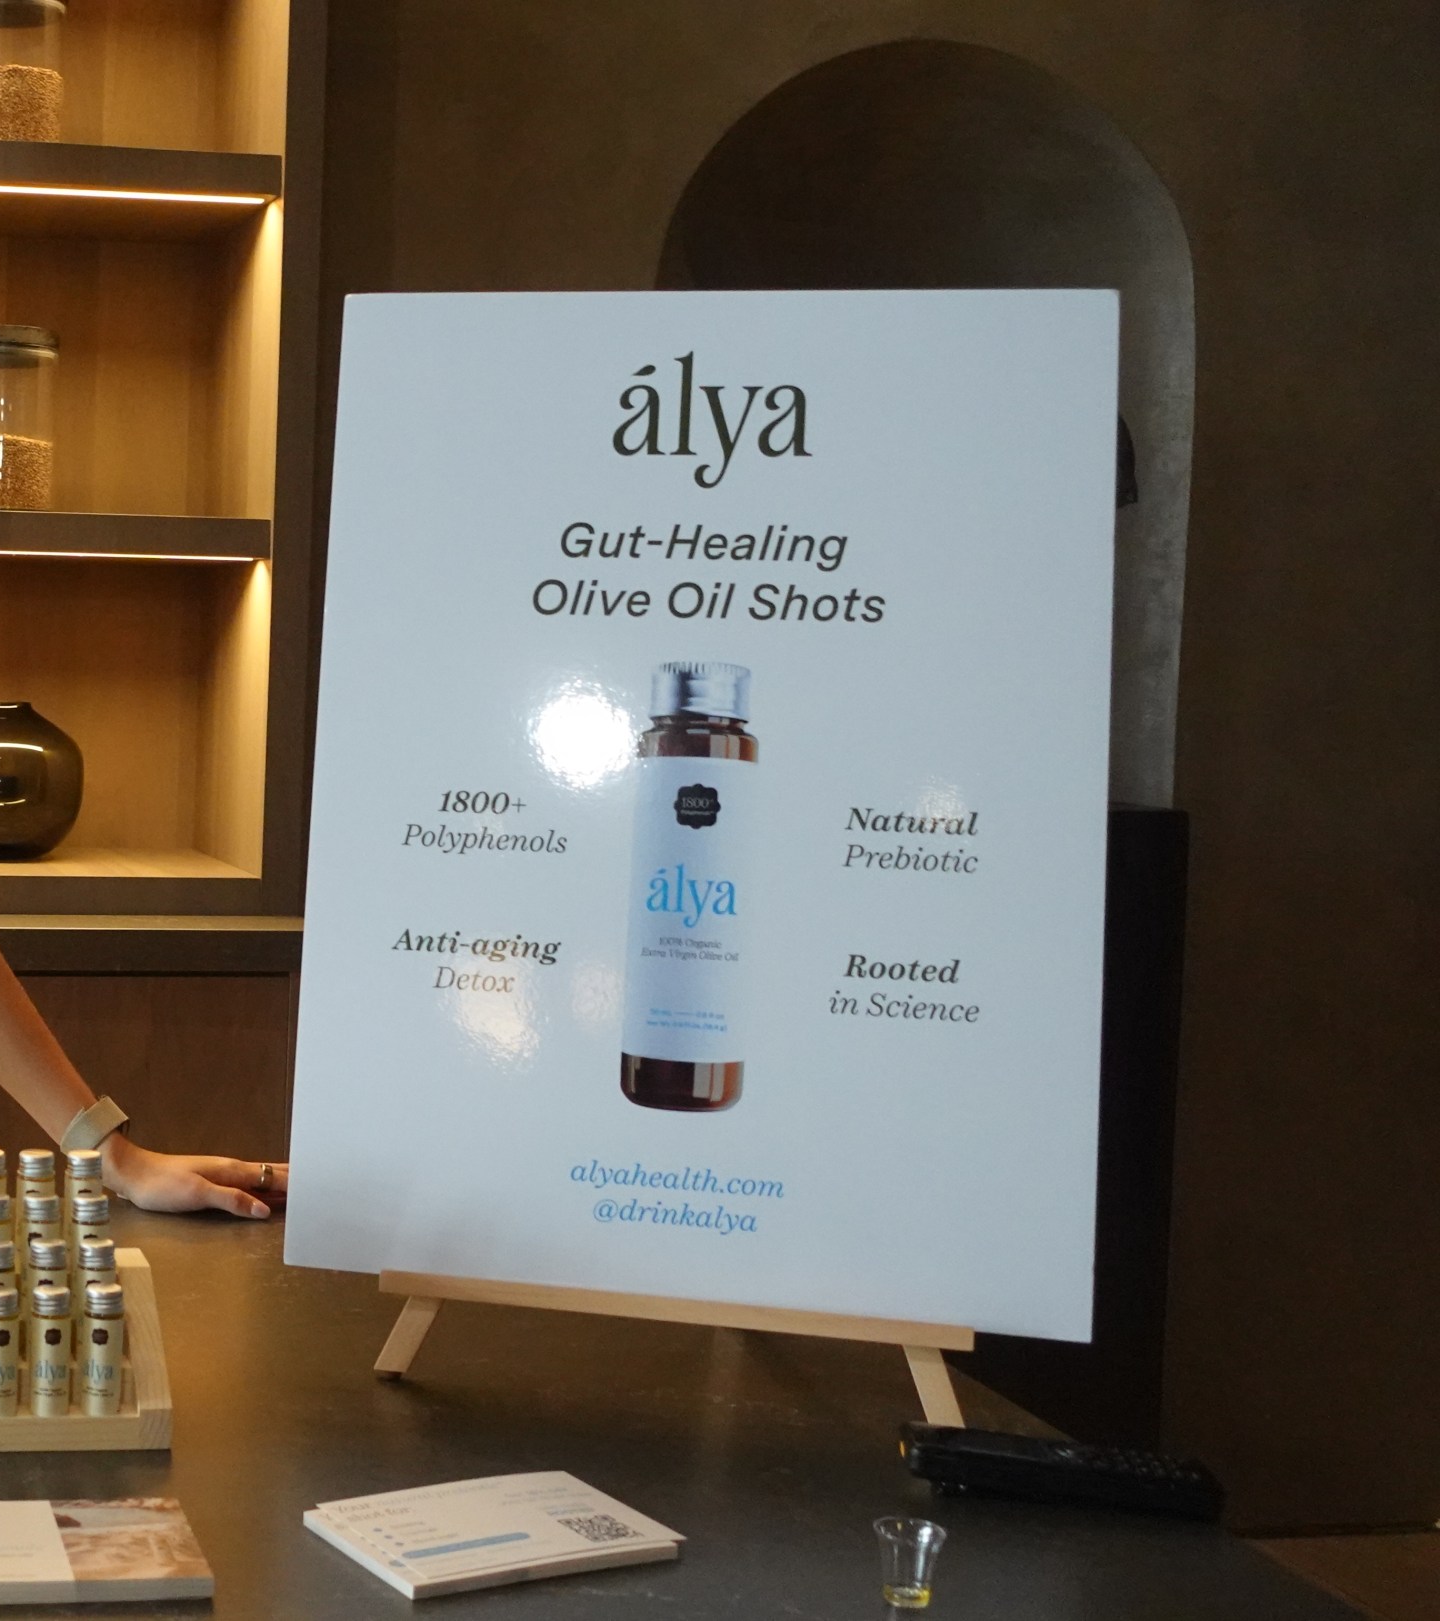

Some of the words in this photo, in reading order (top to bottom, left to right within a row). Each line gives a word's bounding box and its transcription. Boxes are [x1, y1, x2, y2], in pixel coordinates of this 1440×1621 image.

[613, 350, 813, 489] álya
[560, 522, 849, 572] Gut-Healing
[532, 579, 651, 616] Olive
[668, 582, 735, 619] Oil
[748, 584, 886, 623] Shots
[438, 790, 527, 815] 1800+
[845, 807, 979, 836] Natural
[401, 823, 568, 854] Polyphenols
[842, 843, 979, 874] Prebiotic
[646, 863, 737, 929] álya
[392, 928, 562, 966] Anti-aging
[641, 947, 667, 958] Extra
[669, 949, 697, 961] Virgin
[699, 951, 723, 961] Olive
[724, 952, 739, 962] Oil
[432, 965, 516, 993] Detox
[843, 953, 961, 984] Rooted
[829, 990, 859, 1015] in
[865, 992, 980, 1023] Science
[570, 1159, 785, 1199] alyahealth.com
[593, 1198, 758, 1236] @drinkalya
